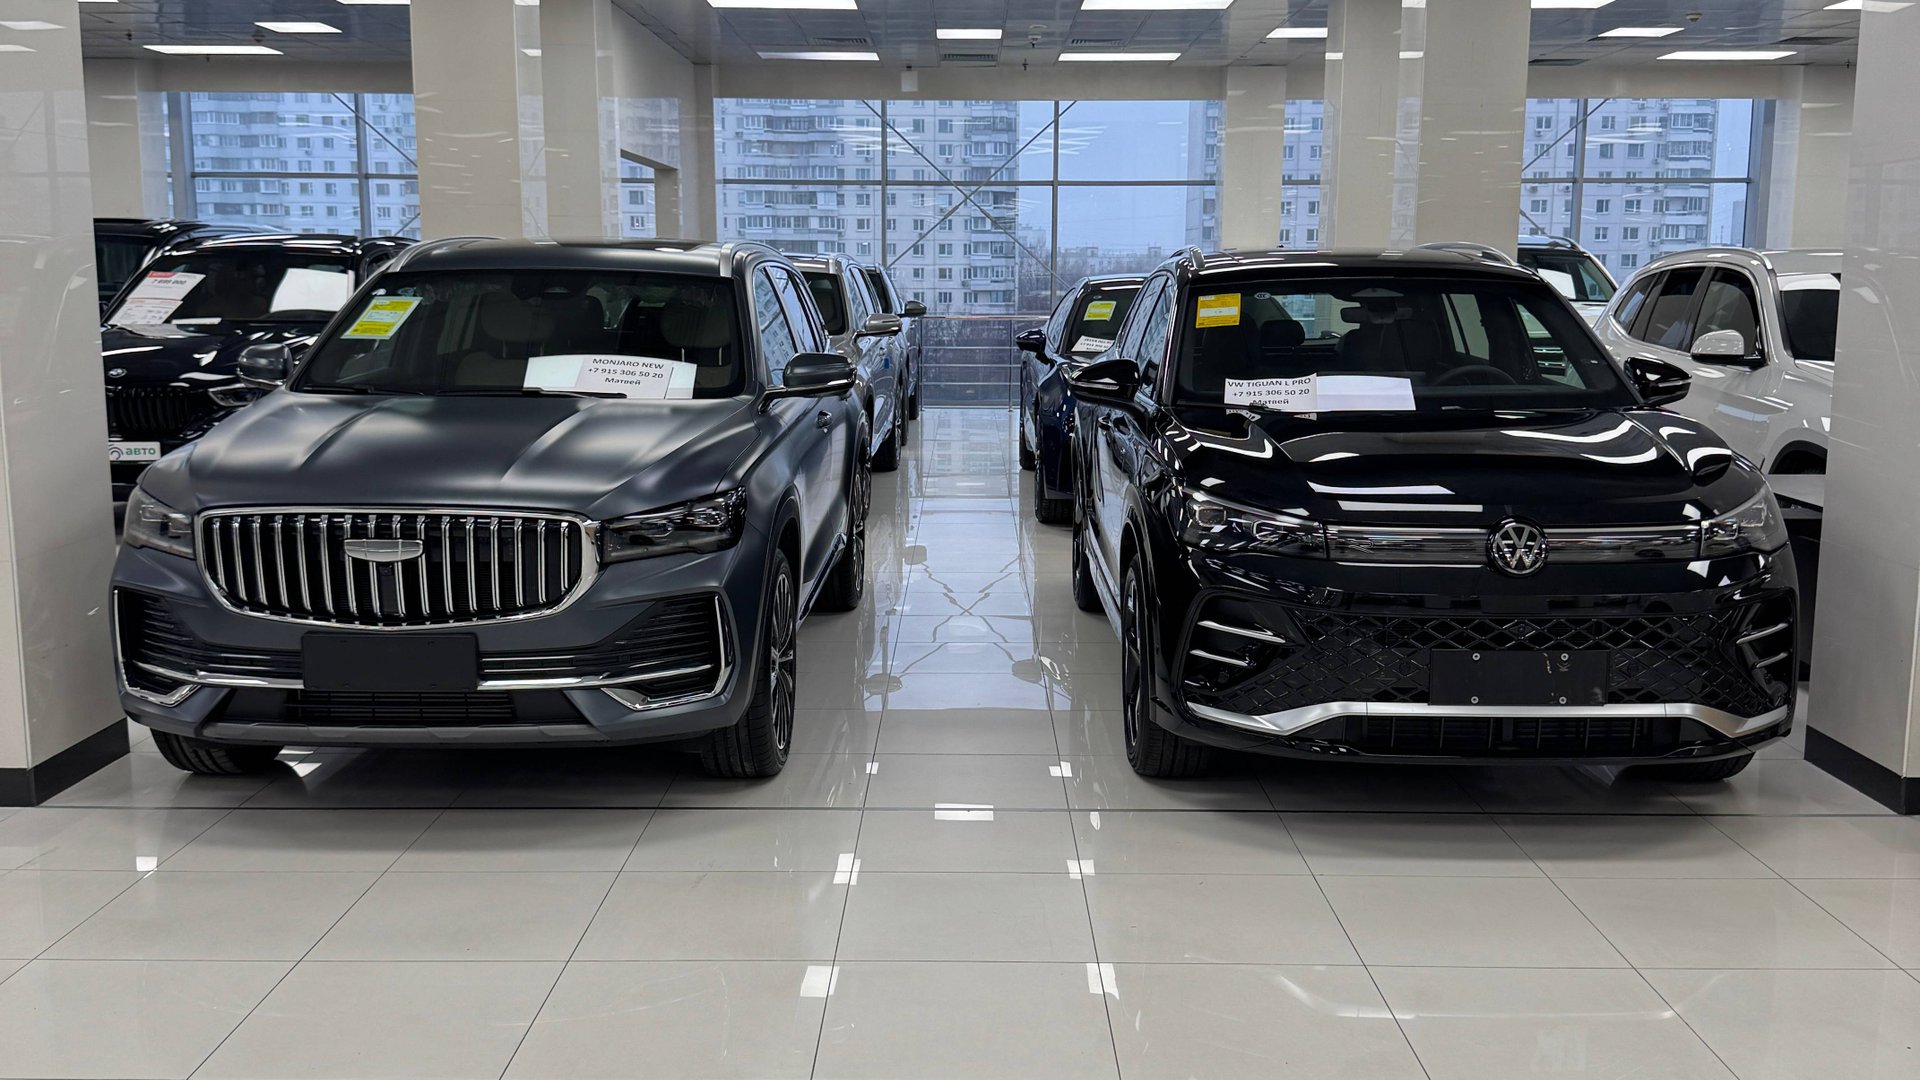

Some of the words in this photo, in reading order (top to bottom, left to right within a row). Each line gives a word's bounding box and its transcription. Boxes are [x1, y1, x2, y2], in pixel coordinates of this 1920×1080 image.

[592, 358, 640, 367] MONJARO
[641, 362, 664, 370] NEW
[604, 377, 641, 385] Матвей
[1247, 380, 1282, 388] TIGUAN
[1292, 377, 1311, 386] PRO
[125, 447, 156, 456] авто
